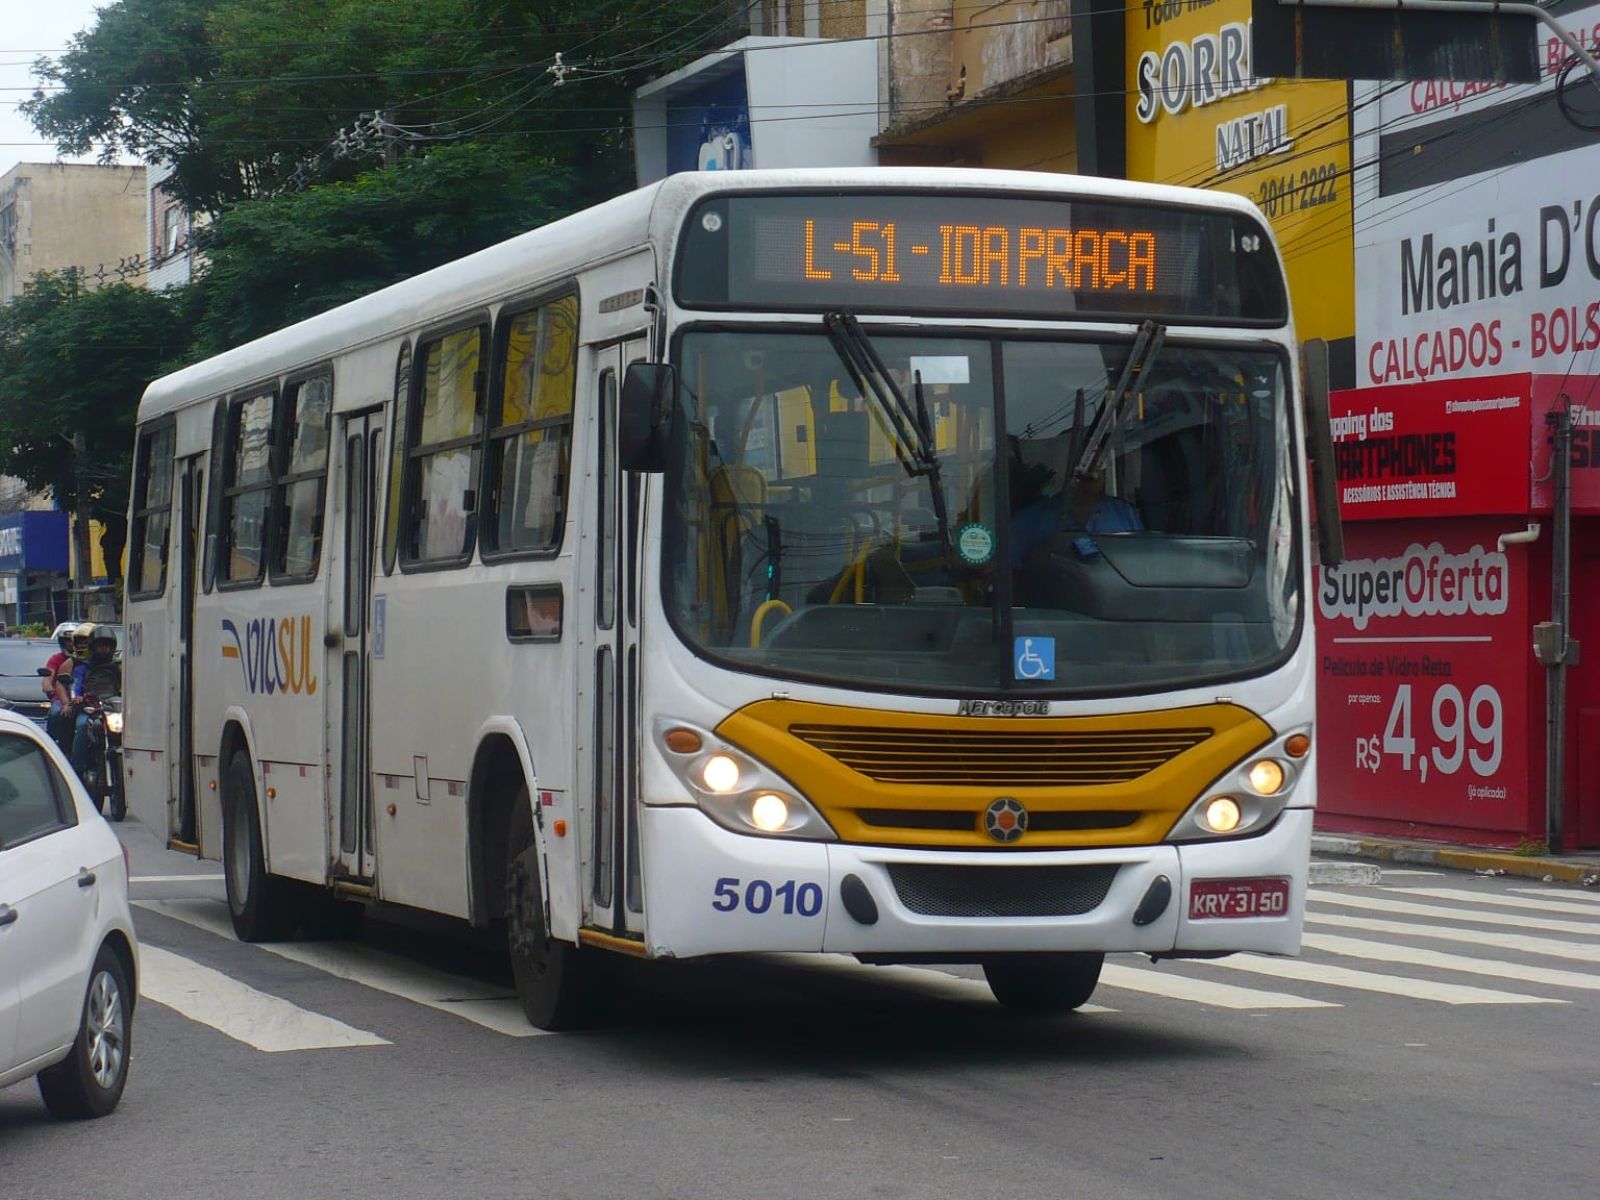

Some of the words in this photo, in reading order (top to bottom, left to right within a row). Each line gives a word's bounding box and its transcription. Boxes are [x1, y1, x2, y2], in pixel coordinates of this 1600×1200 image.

[1216, 104, 1294, 171] NATAL
[939, 224, 1009, 286] IDA
[1018, 227, 1156, 292] PRAÇA
[1401, 217, 1523, 316] Mania
[1368, 319, 1503, 385] CALÇADOS
[1370, 406, 1394, 432] dos
[1323, 552, 1503, 616] SuperOferta
[1356, 734, 1380, 773] R$
[1383, 683, 1503, 783] 4,99
[712, 877, 824, 917] 5010
